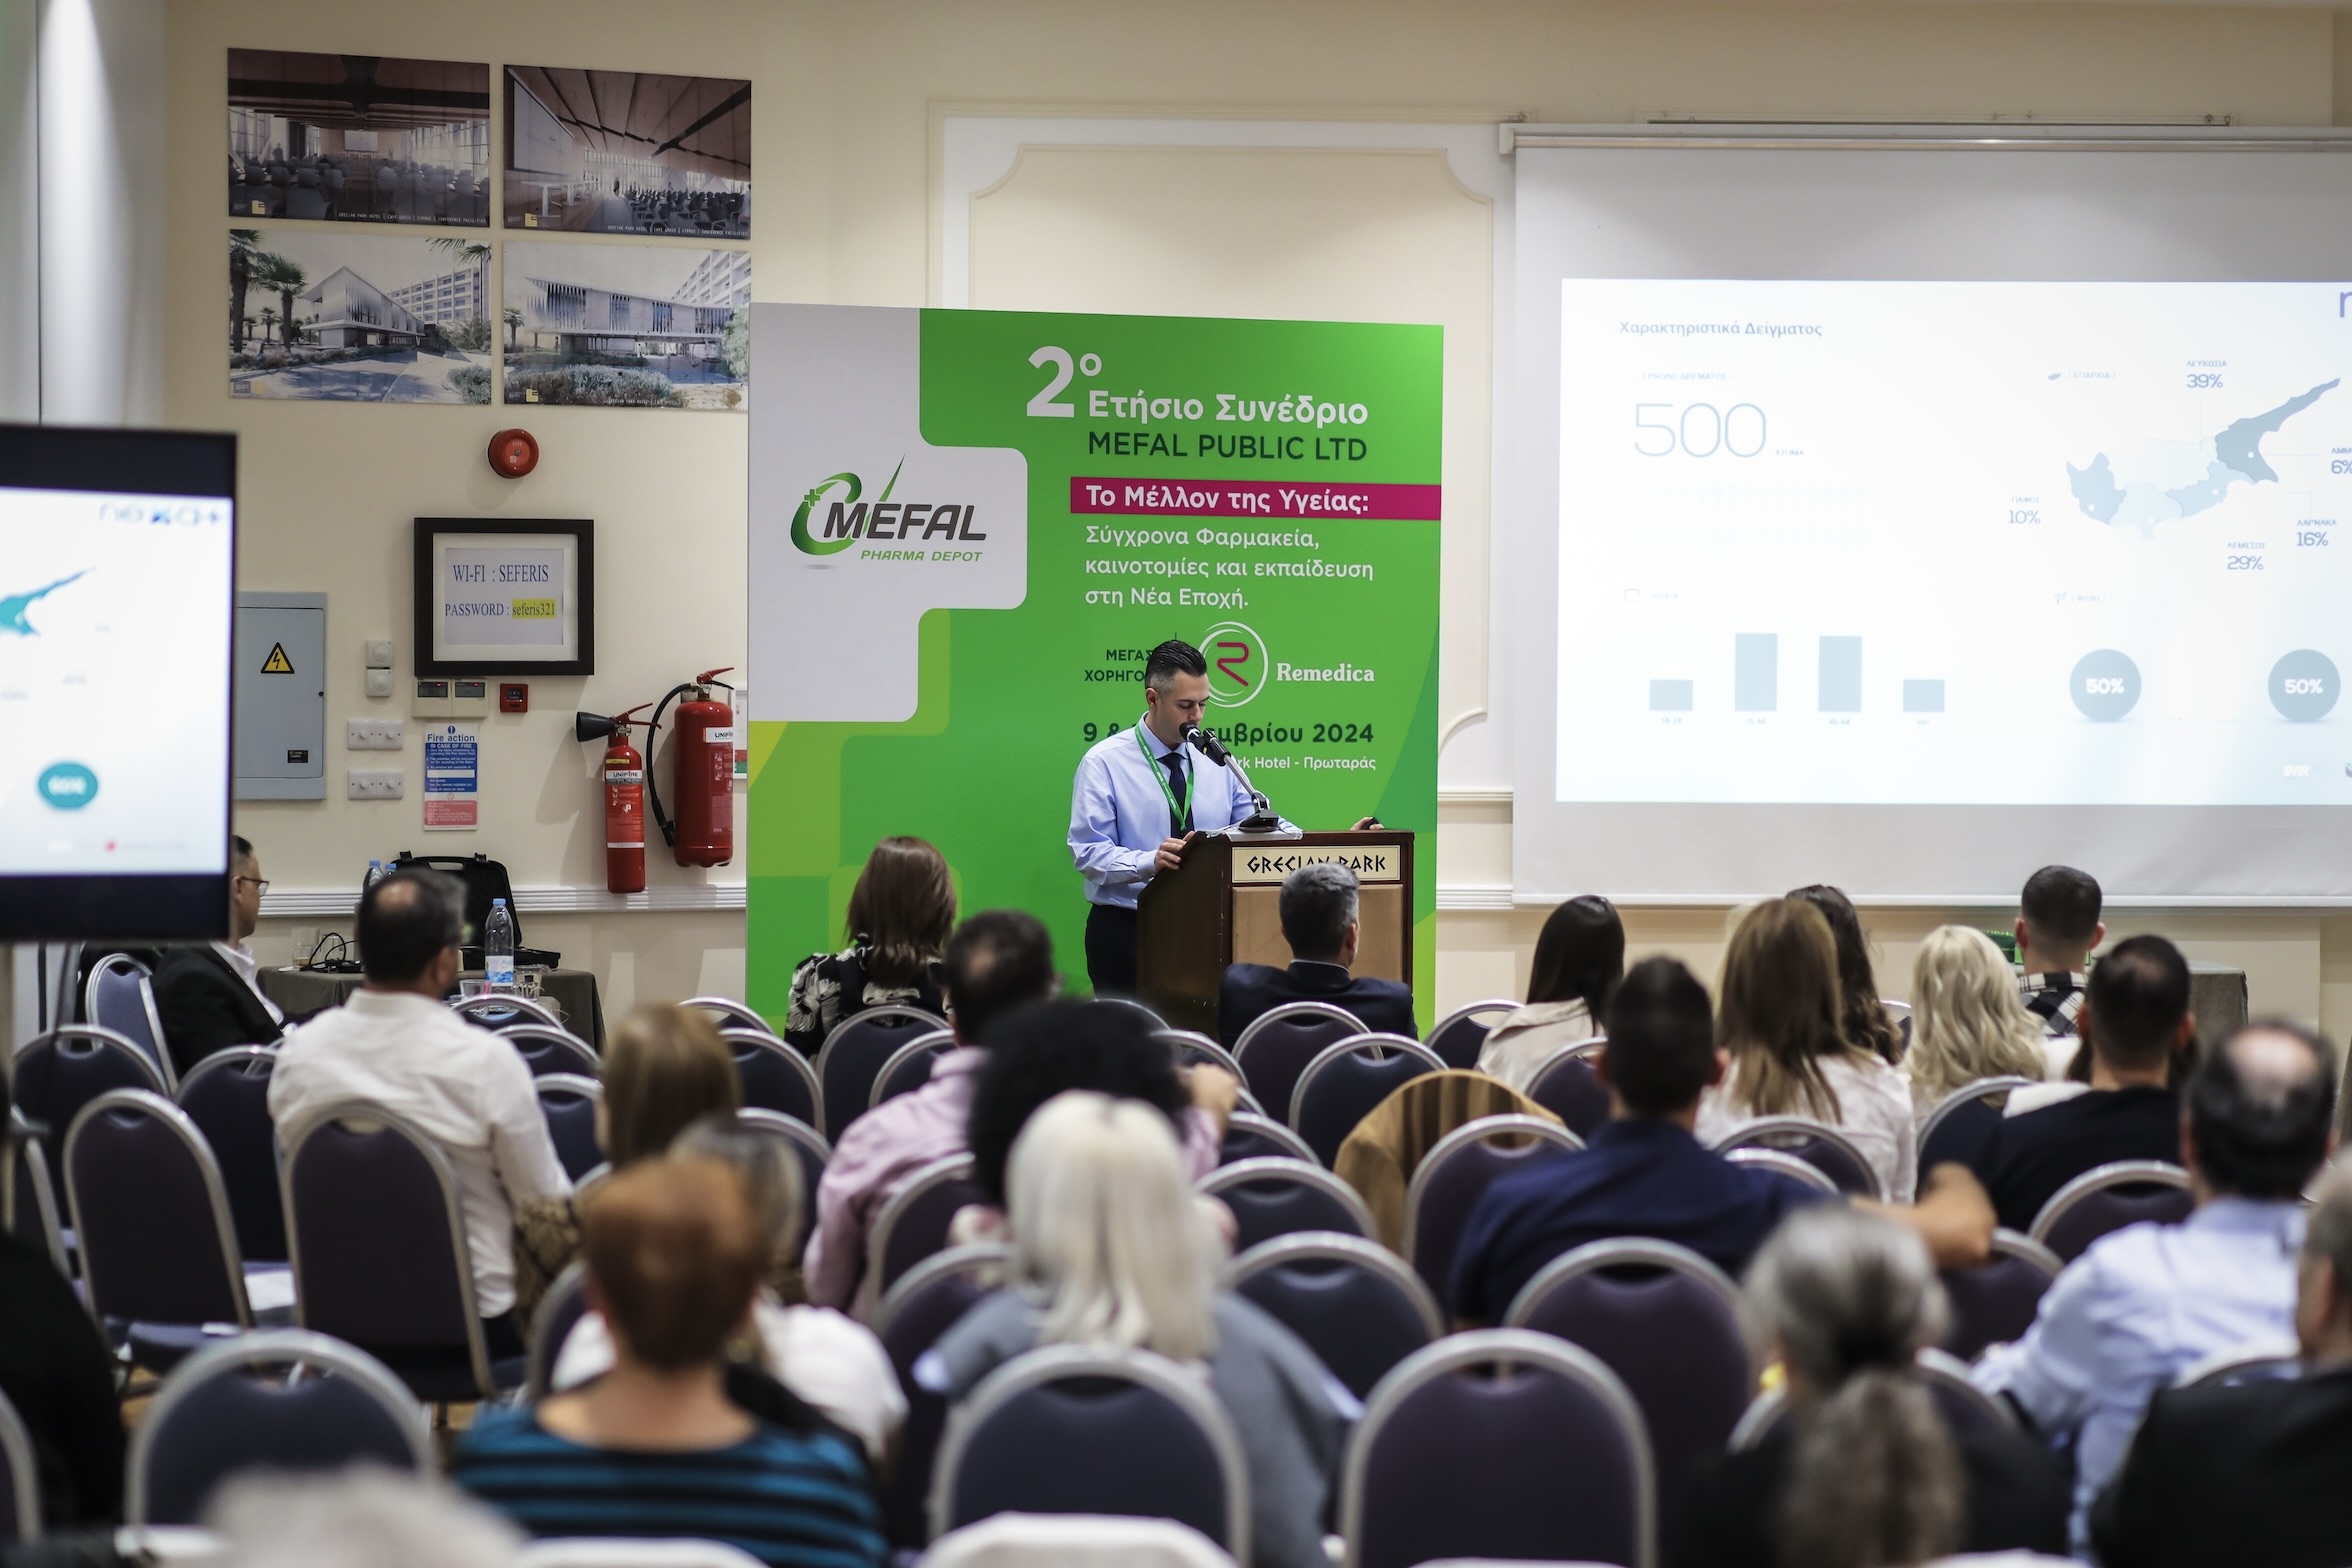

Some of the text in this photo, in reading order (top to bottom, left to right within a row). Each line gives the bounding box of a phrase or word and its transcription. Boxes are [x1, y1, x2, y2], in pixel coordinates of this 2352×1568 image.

[1620, 322, 1822, 338] Χαρακτηριστικά Δείγματος
[2187, 374, 2223, 388] 39%
[1090, 389, 1203, 424] Ετήσιο
[1216, 394, 1368, 429] Συνέδριο
[1635, 403, 1766, 458] 500
[1089, 432, 1366, 460] MEFAL PUBLIC LTD
[1086, 485, 1368, 514] Το Μέλλον της Υγείας:
[823, 502, 987, 541] MEFAL
[2009, 510, 2041, 524] 10%
[1086, 525, 1319, 549] Σύγχρονα Φαρμακεία,
[2297, 532, 2328, 546] 16%
[861, 550, 983, 561] PHARMA DEPOT
[2227, 556, 2263, 570] 29%
[453, 565, 485, 582] WI-FI
[499, 565, 548, 582] SEFERIS
[1086, 557, 1373, 581] καινοτομίες και εκπαίδευση
[1086, 587, 1248, 609] στη Νέα Εποχή.
[445, 604, 504, 616] PASSWORD
[513, 602, 554, 616] seferis321
[1084, 670, 1145, 682] ΧΟΡΗΓΟ
[1277, 663, 1374, 681] Remedica
[2085, 678, 2124, 694] 50%
[2284, 678, 2323, 695] 50%
[1083, 722, 1098, 742] 9
[1206, 722, 1303, 746] μβρίου
[1313, 724, 1373, 743] 2024
[1255, 757, 1290, 768] Hotel
[1304, 756, 1376, 770] Πρωταράς
[1339, 855, 1386, 873] PARK
